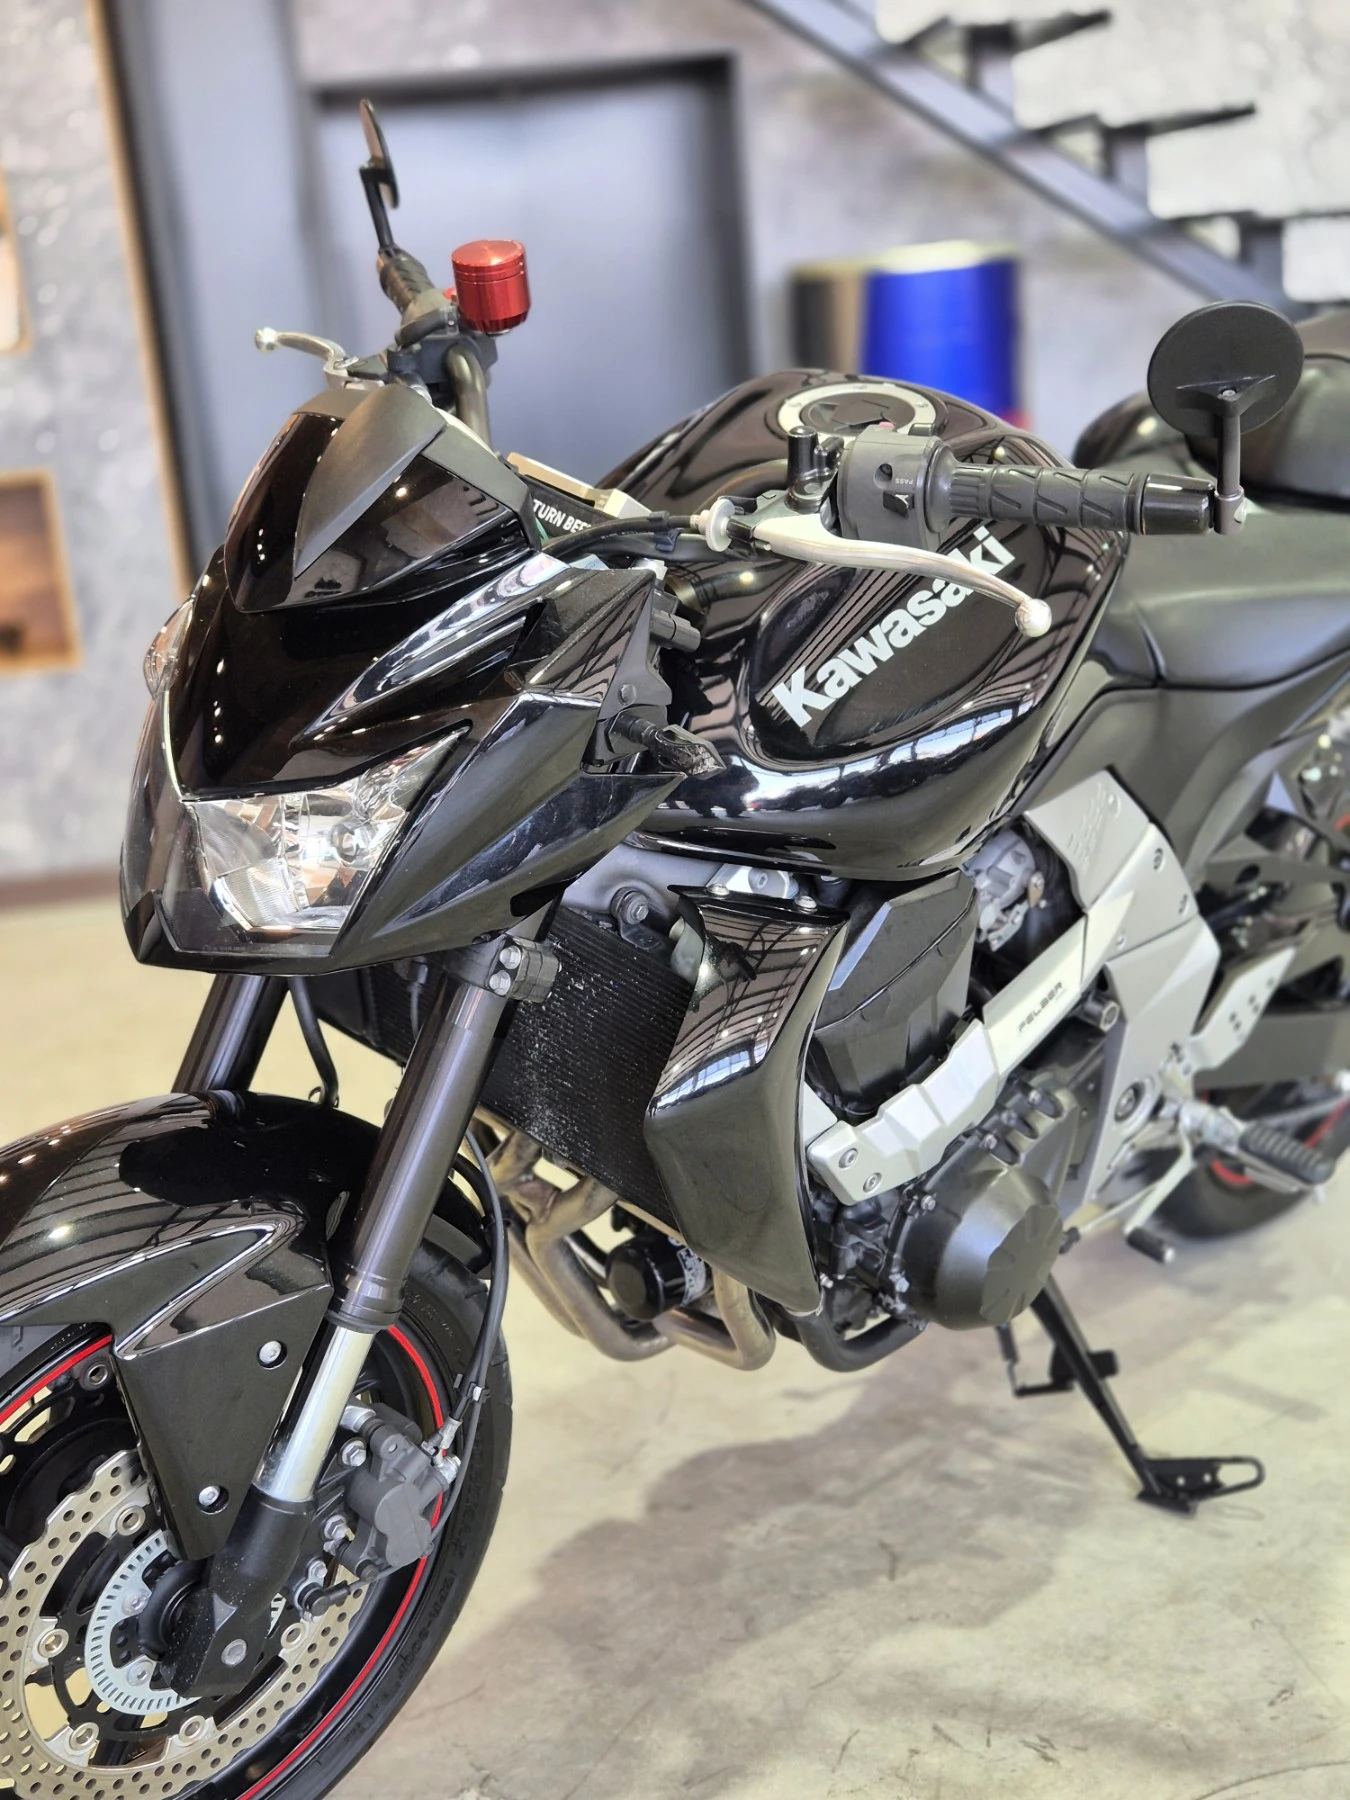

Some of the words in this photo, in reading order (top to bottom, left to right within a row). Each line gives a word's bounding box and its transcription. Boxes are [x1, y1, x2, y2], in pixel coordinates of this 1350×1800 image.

[895, 477, 914, 485] PASS
[533, 498, 566, 528] TURN
[771, 525, 1016, 728] Kawasaki
